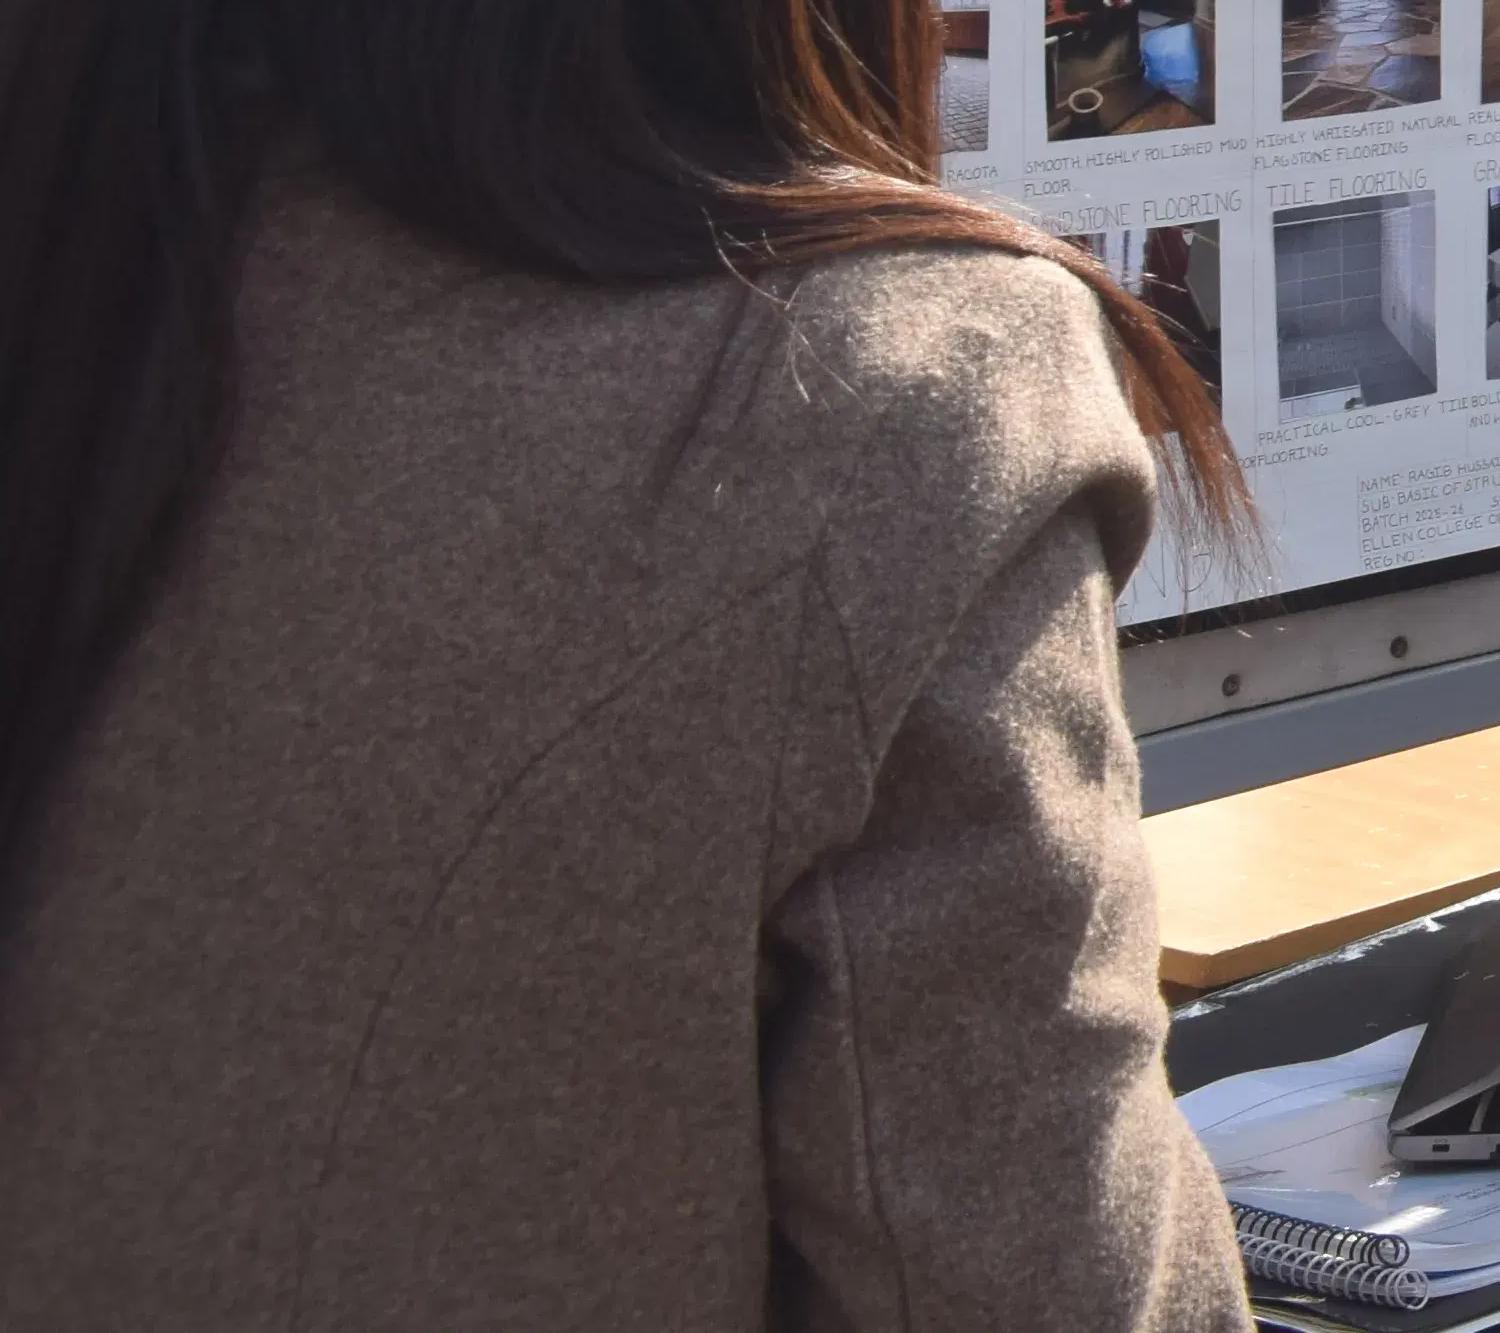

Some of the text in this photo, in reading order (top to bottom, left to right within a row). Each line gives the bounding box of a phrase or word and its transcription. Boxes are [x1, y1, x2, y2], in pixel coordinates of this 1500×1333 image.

[1402, 115, 1460, 130] NATURAL
[1469, 110, 1500, 124] REAL
[1087, 138, 1247, 168] HIGHLY POLISHED MUD
[1267, 169, 1427, 206] TILE FLOORING
[1144, 190, 1241, 222] FLOORING
[1258, 422, 1341, 446] PRACTICAL
[1408, 464, 1452, 484] RAGIB
[1362, 512, 1408, 532] BATCH
[1362, 532, 1413, 552] ELLEN
[1417, 517, 1483, 540] COLLEGE
